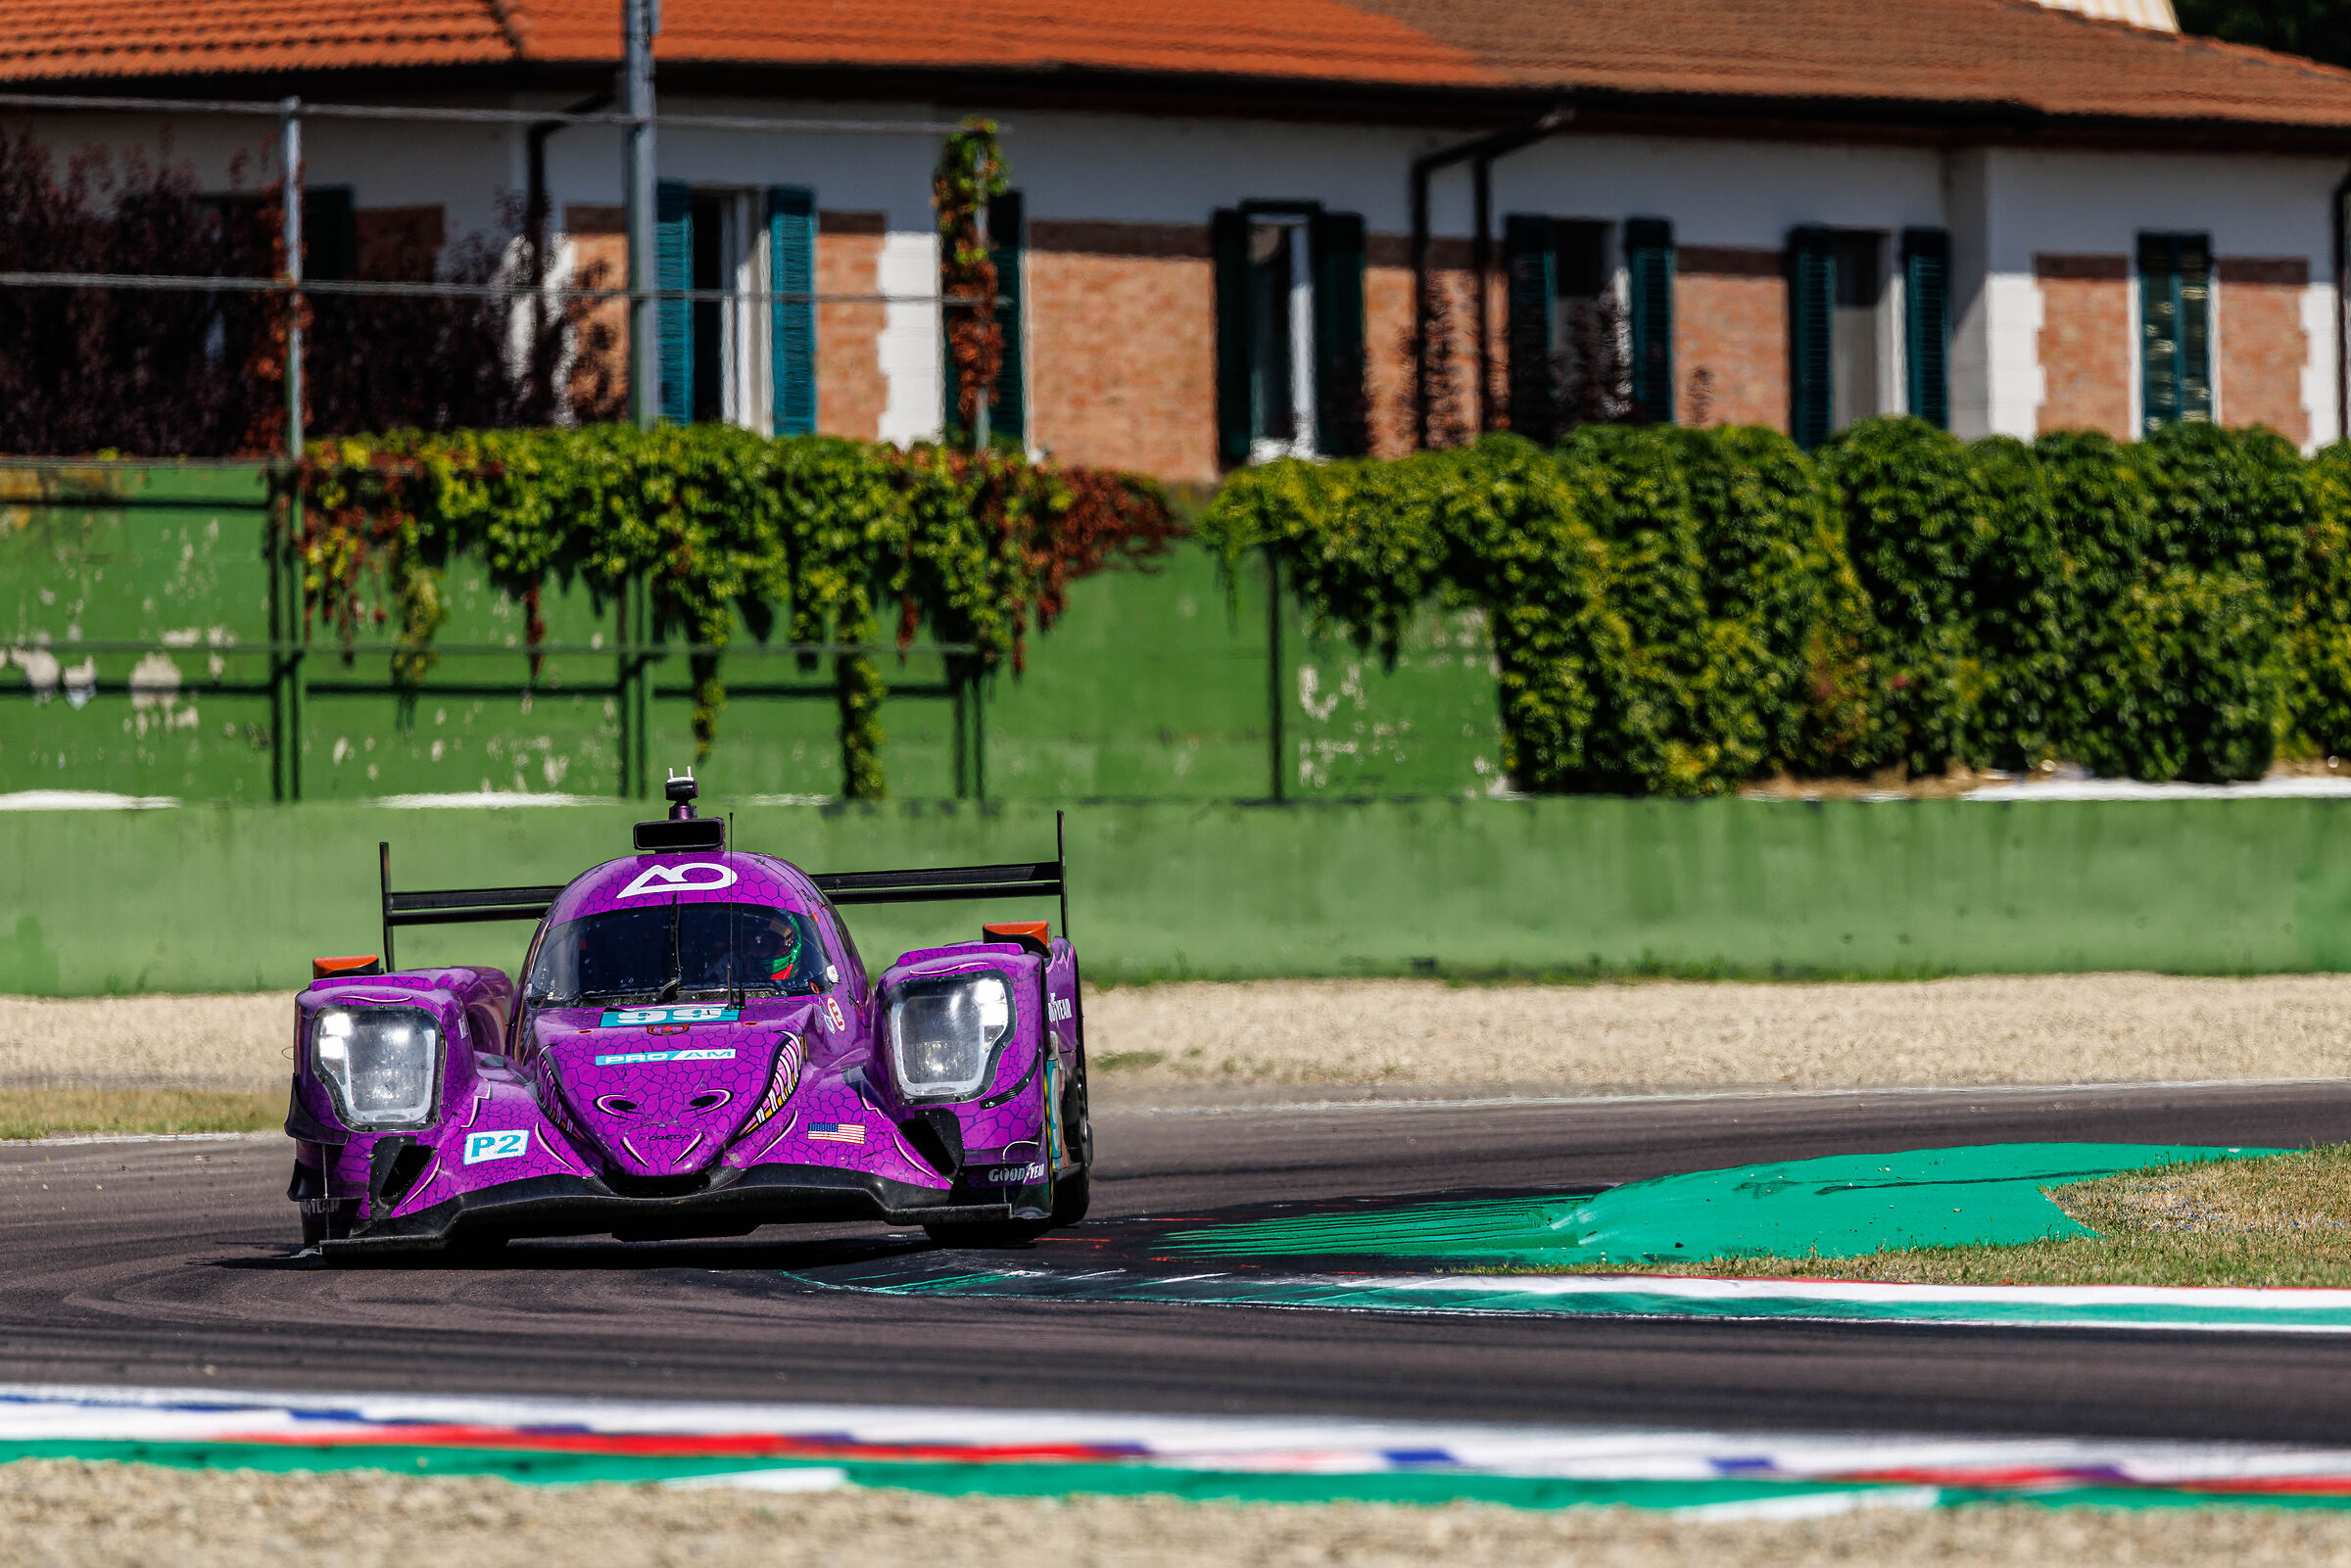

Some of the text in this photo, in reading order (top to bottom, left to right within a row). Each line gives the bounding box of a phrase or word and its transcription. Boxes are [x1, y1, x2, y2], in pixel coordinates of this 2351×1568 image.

[617, 1008, 722, 1024] 99
[605, 1053, 668, 1065] PRO
[471, 1134, 521, 1158] P2
